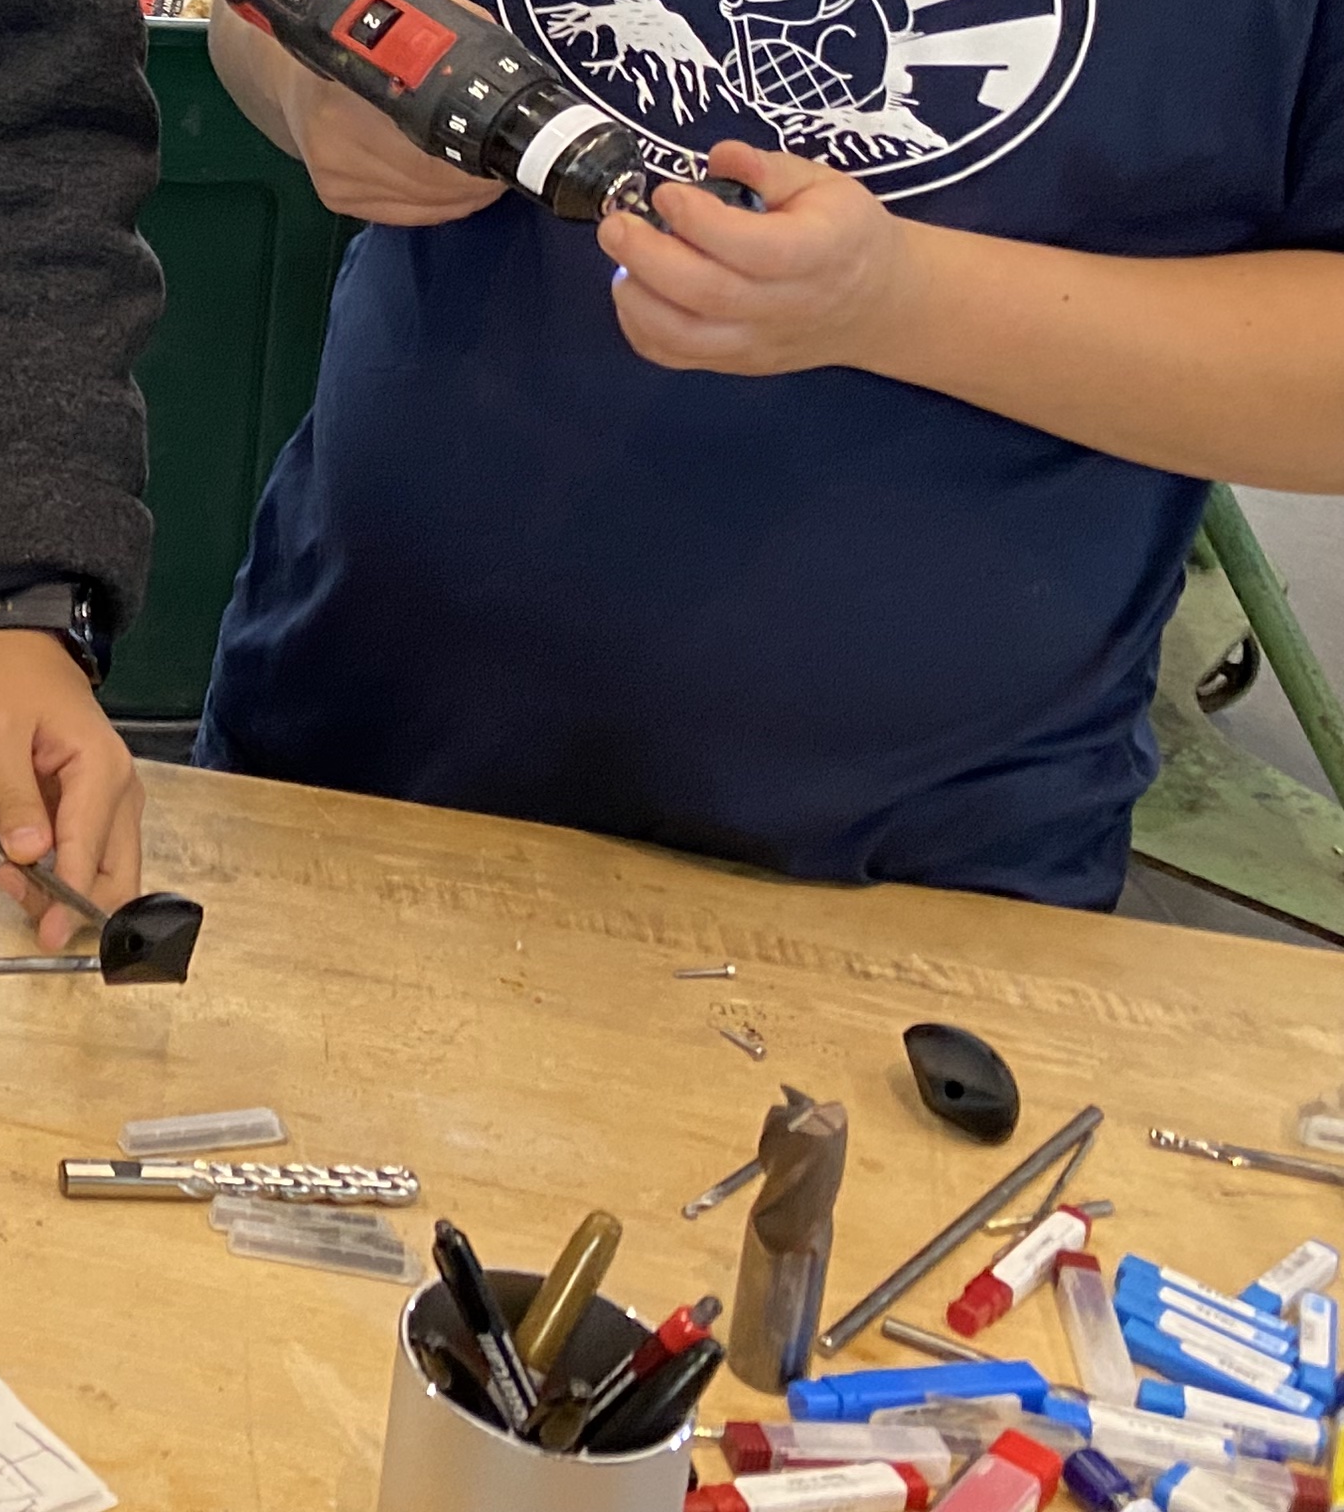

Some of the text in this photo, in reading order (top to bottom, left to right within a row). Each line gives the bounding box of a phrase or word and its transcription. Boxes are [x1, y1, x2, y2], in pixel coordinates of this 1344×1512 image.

[363, 13, 381, 29] 2
[498, 56, 520, 74] 12
[467, 79, 489, 100] 14
[448, 114, 467, 134] 16
